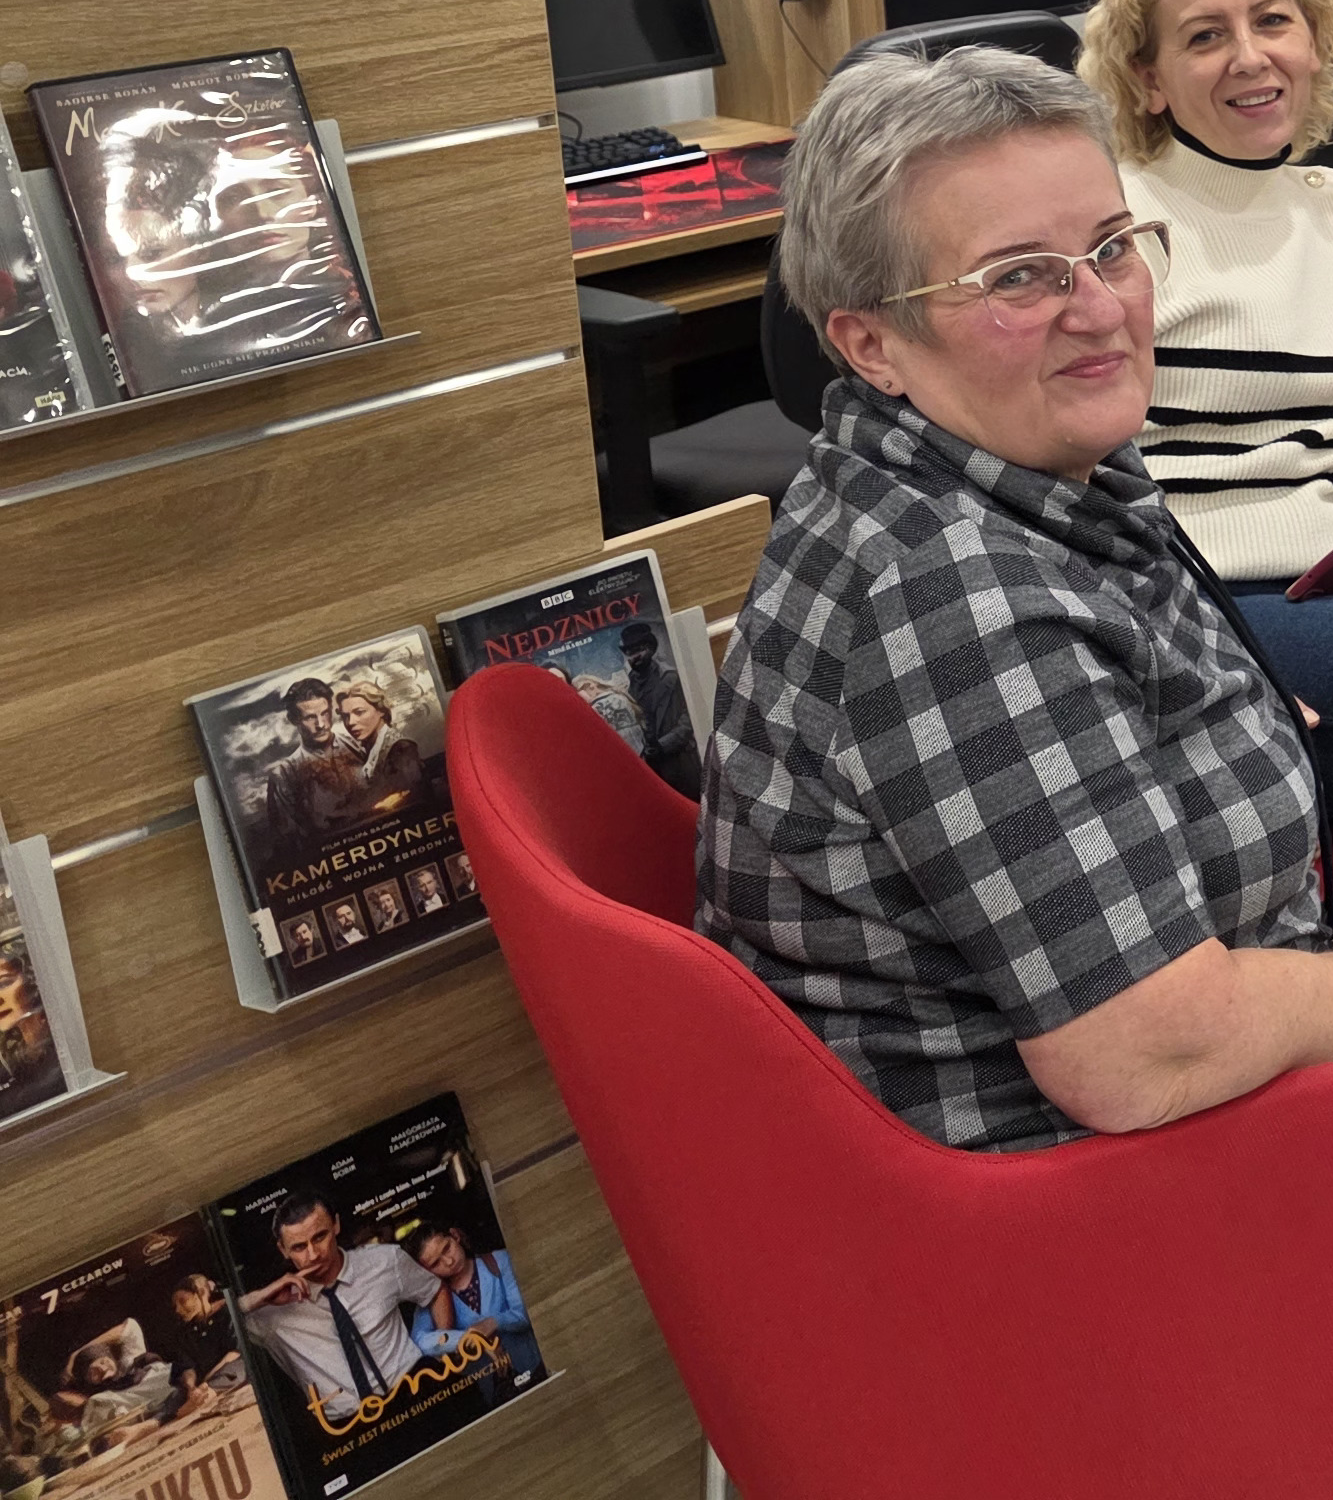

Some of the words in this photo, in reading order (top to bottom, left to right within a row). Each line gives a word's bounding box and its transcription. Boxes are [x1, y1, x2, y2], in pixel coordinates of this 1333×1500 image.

[114, 85, 157, 99] RONAN
[171, 76, 221, 90] MARGOT
[483, 593, 642, 664] NĘDZNICY
[542, 590, 573, 609] BBC
[265, 811, 457, 895] KAMERDYNER
[287, 879, 334, 905] MIŁOŚĆ
[342, 862, 385, 883] WOJNA
[394, 834, 455, 863] ZBRODNIA
[331, 1155, 354, 1172] ADAM
[40, 1288, 59, 1314] 7
[61, 1258, 124, 1293] CEZARÓW
[307, 1330, 500, 1436] tonia
[321, 1441, 355, 1467] ŚWIAT
[357, 1428, 378, 1447] JEST
[410, 1388, 451, 1417] SILNYCH
